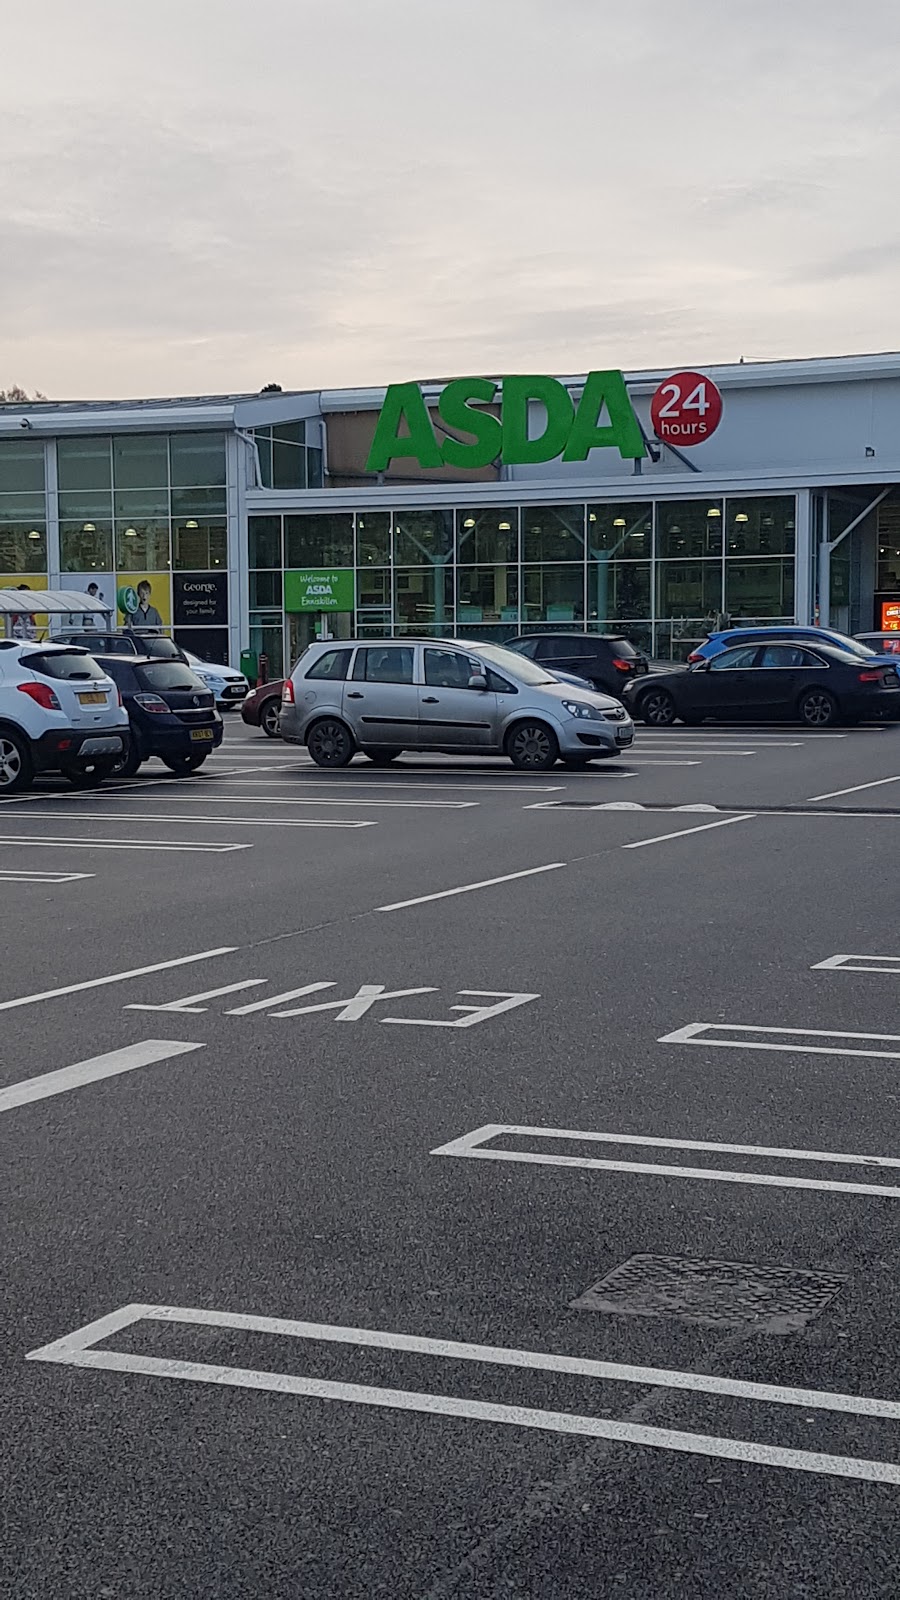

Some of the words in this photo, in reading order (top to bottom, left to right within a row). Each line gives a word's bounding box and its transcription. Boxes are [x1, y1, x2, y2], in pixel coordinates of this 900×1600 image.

[658, 382, 710, 418] 24
[365, 369, 648, 472] ASDA
[661, 420, 707, 435] hours
[299, 574, 330, 583] Welcome
[331, 574, 339, 583] to
[305, 585, 333, 595] ASDA
[301, 596, 338, 606] Enniskillen
[123, 978, 542, 1028] EXIT
